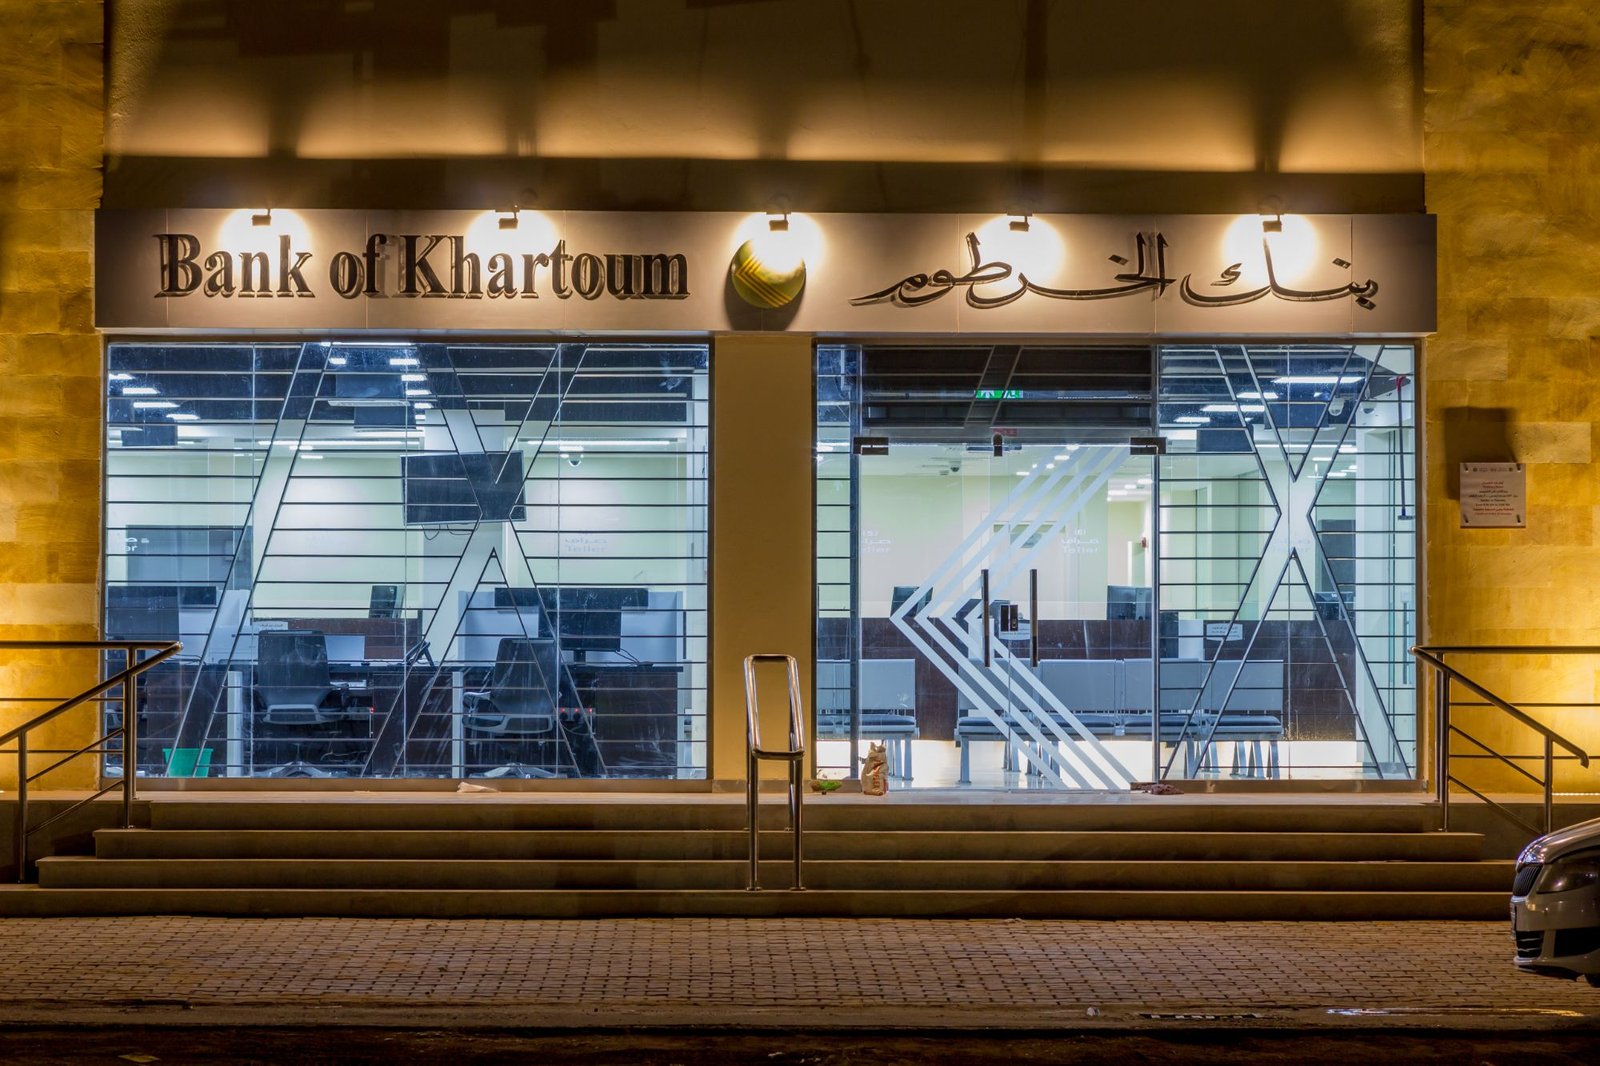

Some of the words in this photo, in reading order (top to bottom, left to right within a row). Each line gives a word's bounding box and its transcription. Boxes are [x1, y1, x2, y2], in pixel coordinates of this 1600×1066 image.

[154, 233, 315, 298] Bank
[329, 233, 388, 299] of
[398, 234, 690, 300] Khartoum
[849, 231, 1177, 309] الخرطوم
[1179, 234, 1378, 311] بنك
